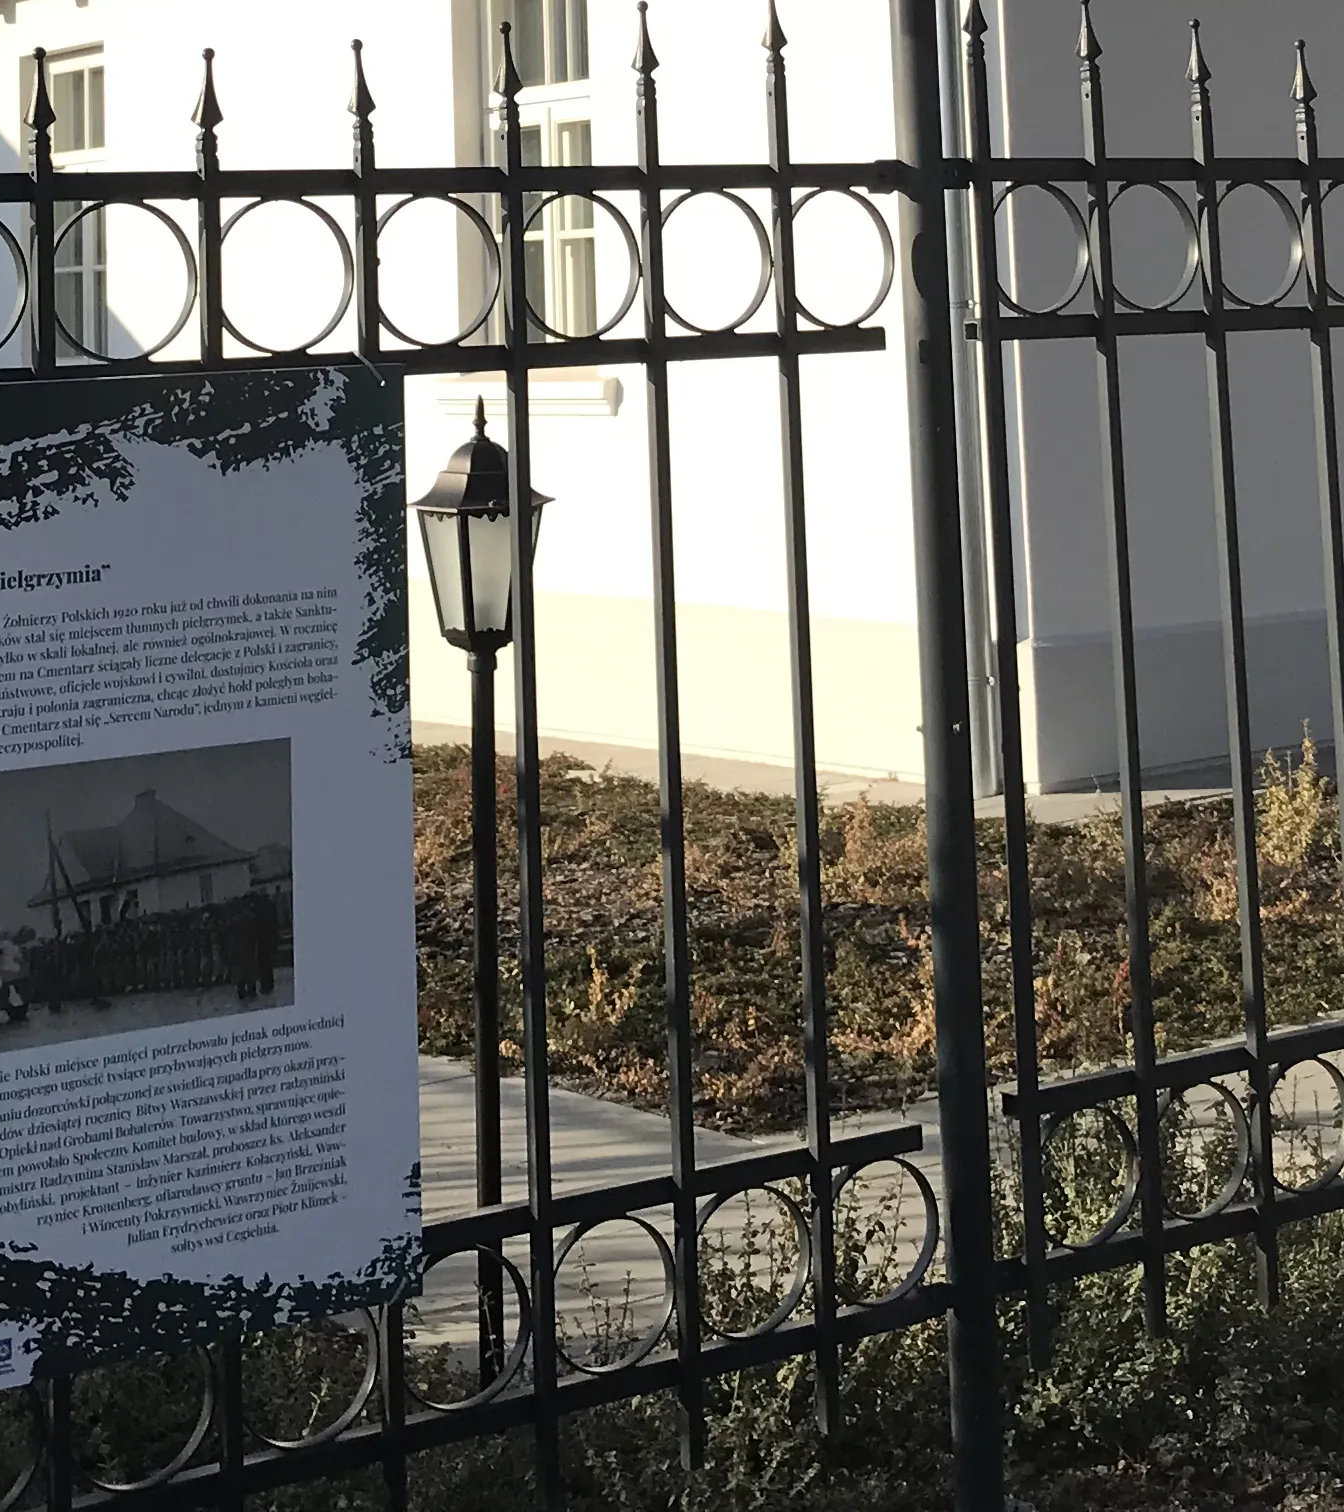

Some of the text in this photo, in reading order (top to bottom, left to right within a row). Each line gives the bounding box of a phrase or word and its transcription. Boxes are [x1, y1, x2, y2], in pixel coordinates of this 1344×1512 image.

[3, 613, 57, 628] Żołnierzy
[61, 606, 109, 622] Polskich
[141, 601, 167, 615] roku
[189, 598, 203, 611] od
[206, 595, 239, 609] chwili
[242, 590, 297, 606] dokonania
[300, 591, 313, 600] na
[316, 586, 337, 599] nim
[40, 646, 66, 660] skali
[123, 639, 138, 652] ale
[293, 620, 337, 635] rocznicę
[68, 625, 122, 640] miejscem
[126, 617, 178, 634] tłumnych
[19, 671, 33, 679] na
[37, 664, 94, 678] Cmentarz
[145, 654, 177, 667] liczne
[180, 647, 231, 664] delegacje
[243, 642, 275, 657] Polski
[103, 672, 155, 690] wojskowi
[156, 687, 188, 701] chcąc
[1, 721, 59, 734] Cmentarz
[203, 699, 243, 716] jednym
[254, 691, 297, 707] kamieni
[15, 1062, 50, 1079] Polski
[54, 1057, 98, 1072] miejsce
[103, 1046, 147, 1067] pamięci
[231, 1025, 268, 1046] jednak
[271, 1013, 344, 1037] odpowiedniej
